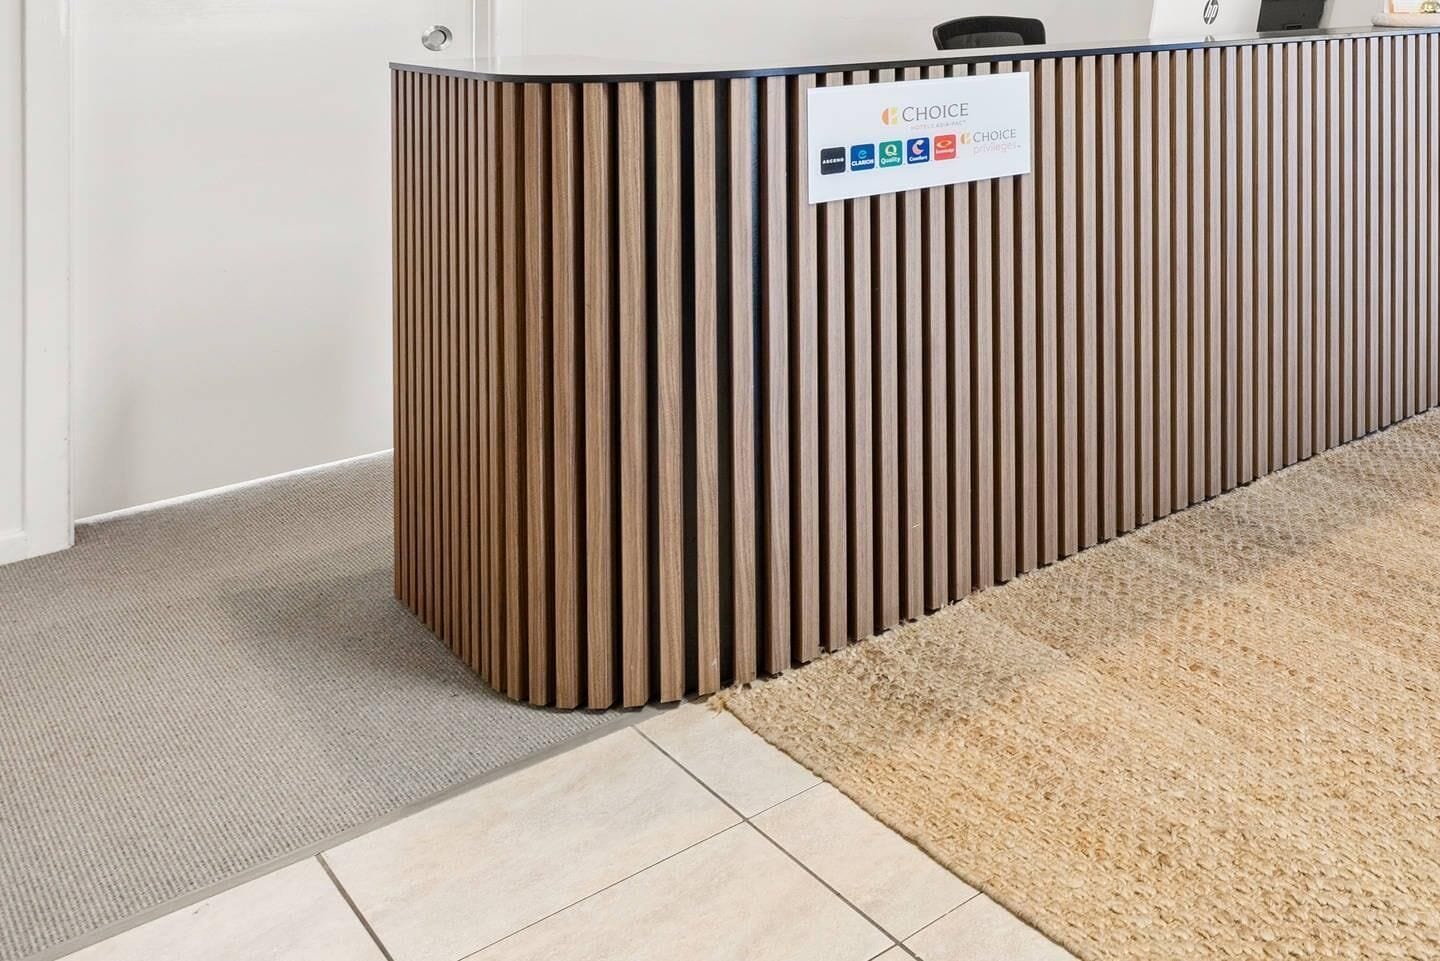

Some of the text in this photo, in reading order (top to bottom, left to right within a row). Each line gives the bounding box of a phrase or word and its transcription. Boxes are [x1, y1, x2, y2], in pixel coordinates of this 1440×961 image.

[902, 102, 969, 123] CHOICE
[972, 128, 1017, 143] CHOICE
[851, 158, 874, 167] CLARION
[880, 156, 901, 165] Quality
